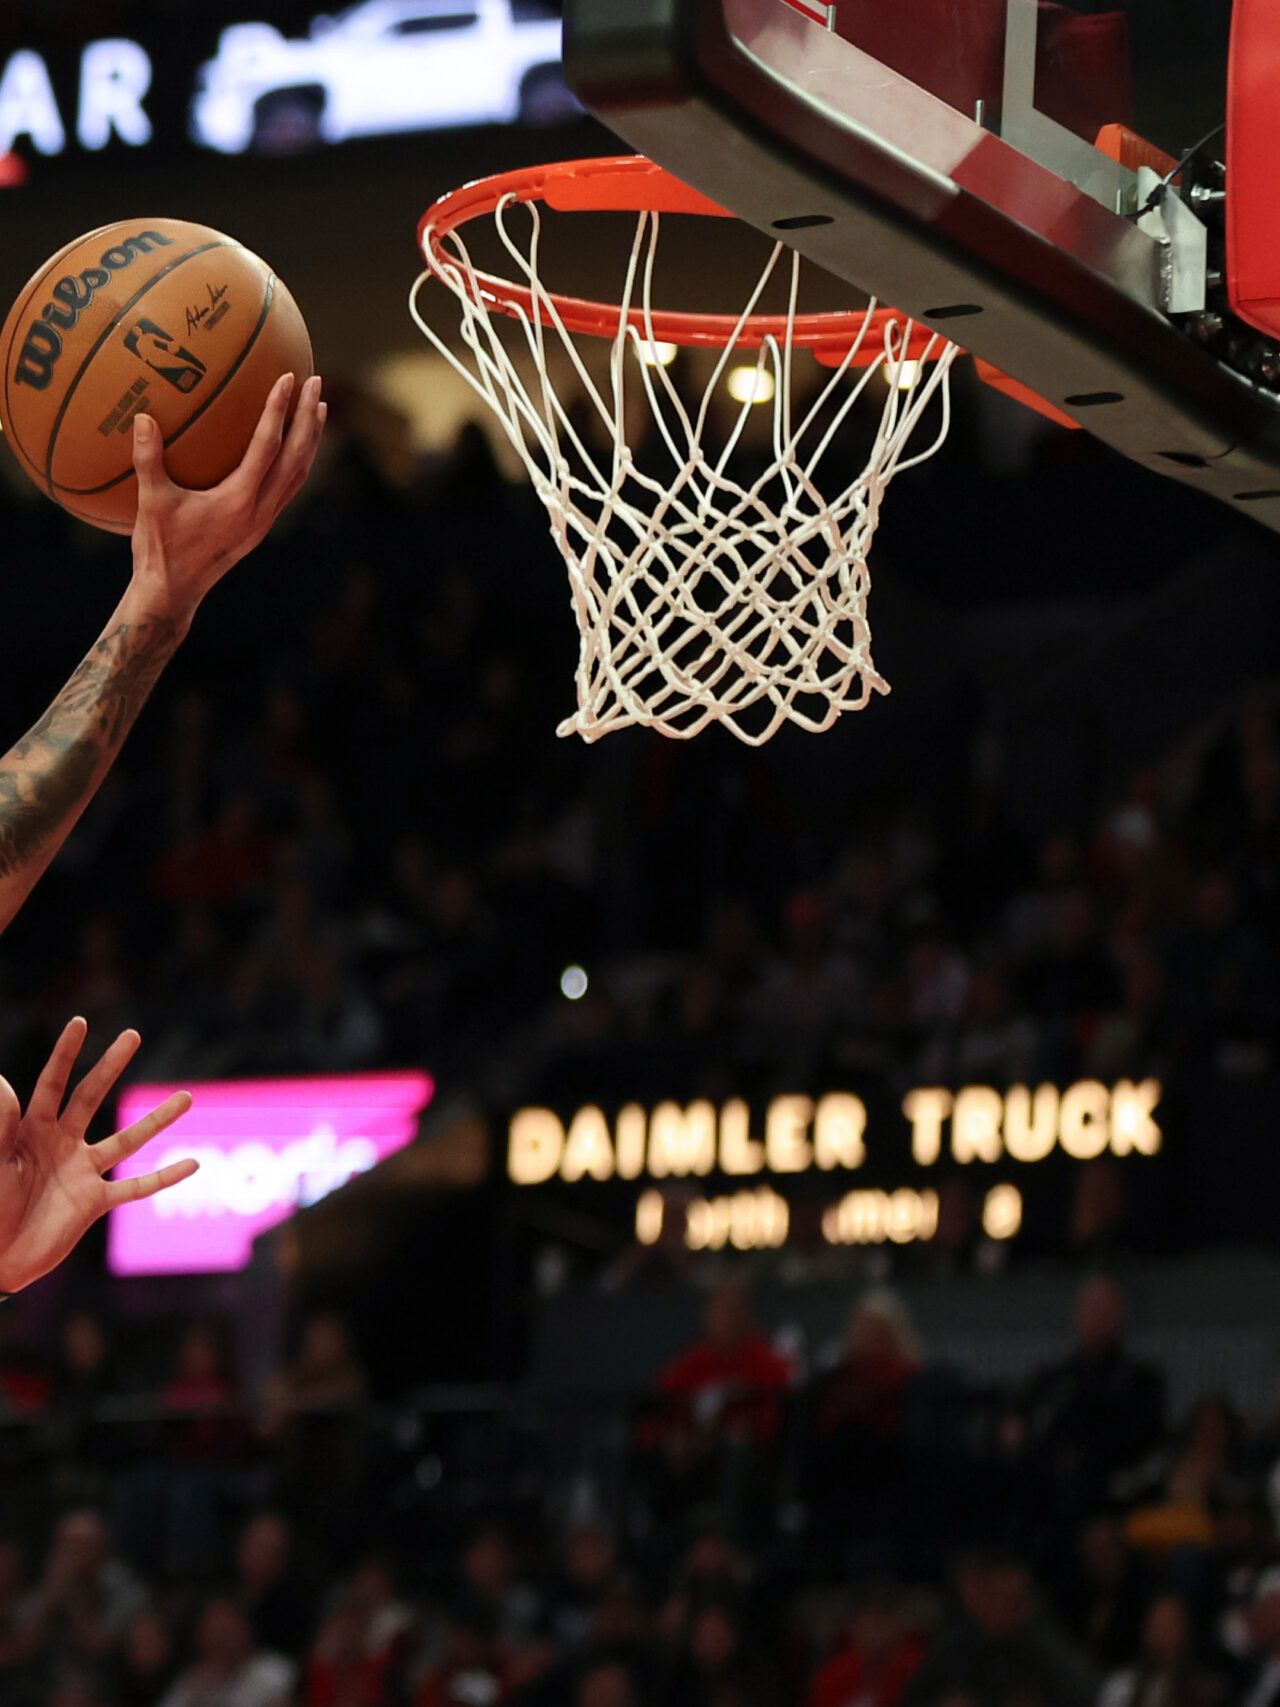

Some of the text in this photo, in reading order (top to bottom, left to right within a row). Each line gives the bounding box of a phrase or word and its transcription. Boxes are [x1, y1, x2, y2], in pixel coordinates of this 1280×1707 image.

[14, 229, 175, 391] Wilson
[506, 1076, 1164, 1186] DAIMLER TRUCK
